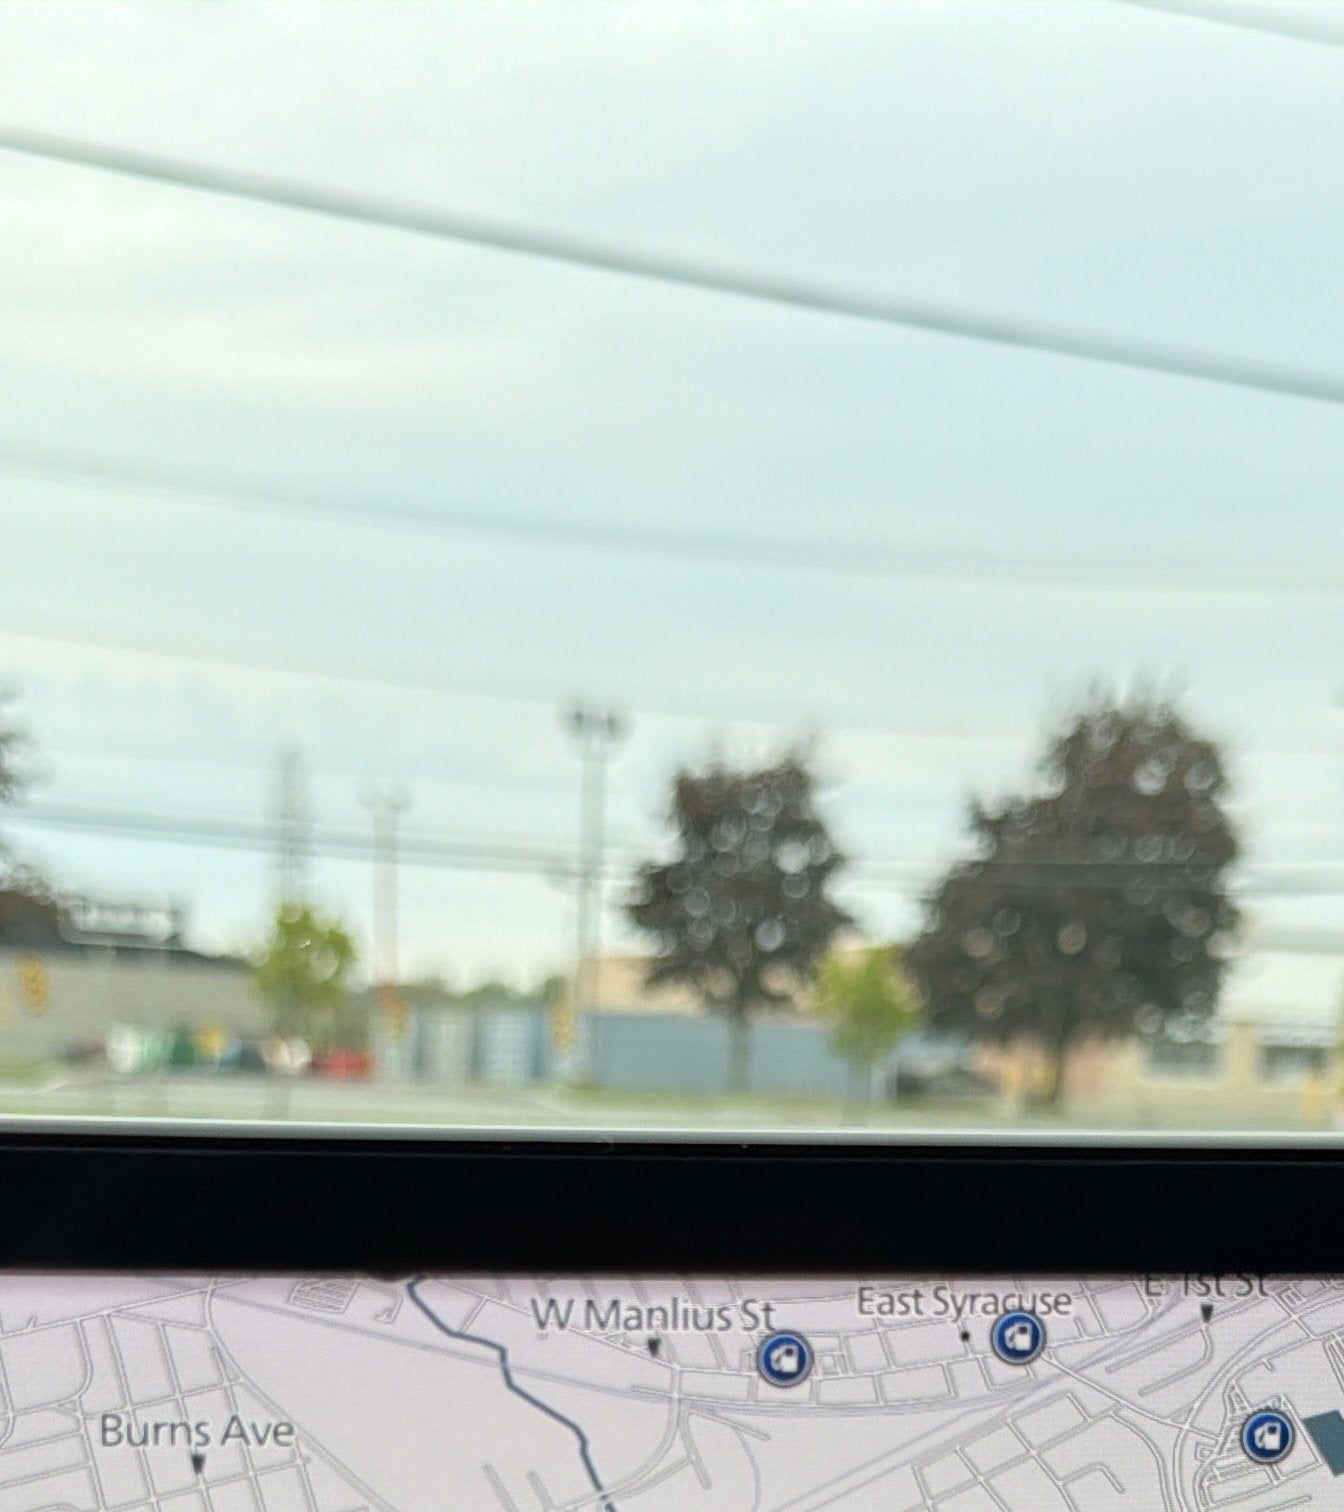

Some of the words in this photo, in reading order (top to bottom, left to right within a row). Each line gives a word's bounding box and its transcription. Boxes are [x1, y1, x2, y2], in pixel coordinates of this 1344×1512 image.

[531, 1299, 572, 1330] W
[584, 1297, 731, 1332] Manlius
[740, 1299, 776, 1332] St
[858, 1286, 924, 1316] East
[933, 1286, 1072, 1323] Syracuse
[99, 1414, 211, 1448] Burns
[220, 1414, 295, 1448] Ave
